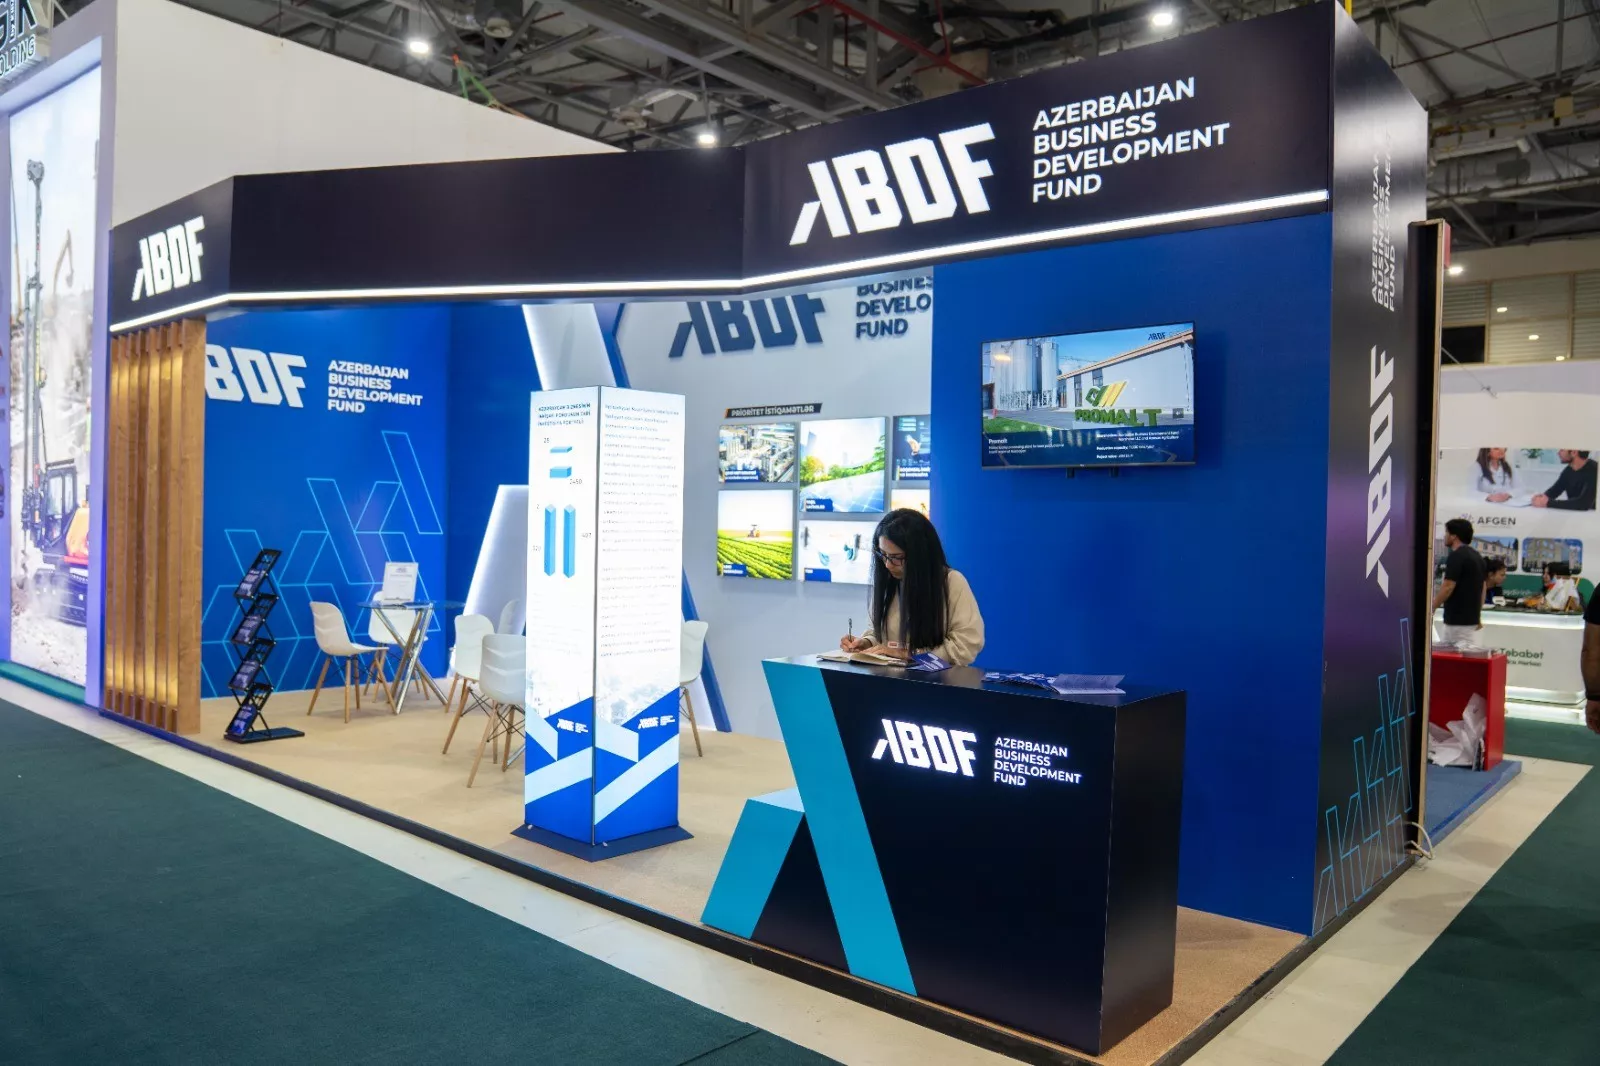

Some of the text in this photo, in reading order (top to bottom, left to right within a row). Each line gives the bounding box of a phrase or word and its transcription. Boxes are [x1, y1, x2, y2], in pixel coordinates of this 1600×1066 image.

[1033, 77, 1195, 131] AZERBAIJAN
[1034, 112, 1157, 155] BUSINESS
[1033, 123, 1230, 179] DEVELOPMENT
[790, 122, 995, 246] ABDF
[1033, 174, 1102, 203] FUND
[1377, 186, 1385, 305] BUSINESS
[131, 216, 205, 302] ABDF
[856, 294, 932, 317] DEVELO
[856, 318, 909, 338] FUND
[328, 360, 409, 380] AZERBAIJAN
[328, 373, 392, 391] BUSINESS
[328, 386, 423, 406] DEVELOPMENT
[328, 399, 366, 413] FUND
[1074, 408, 1162, 428] PROMALT
[1366, 344, 1395, 598] ABDF
[1476, 516, 1516, 525] AFGEN
[872, 718, 977, 777] ABDF
[995, 737, 1068, 757] AZERBAIJAN
[995, 748, 1051, 767] BUSINESS
[994, 760, 1082, 784] DEVELOPMENT
[994, 771, 1027, 786] FUND
